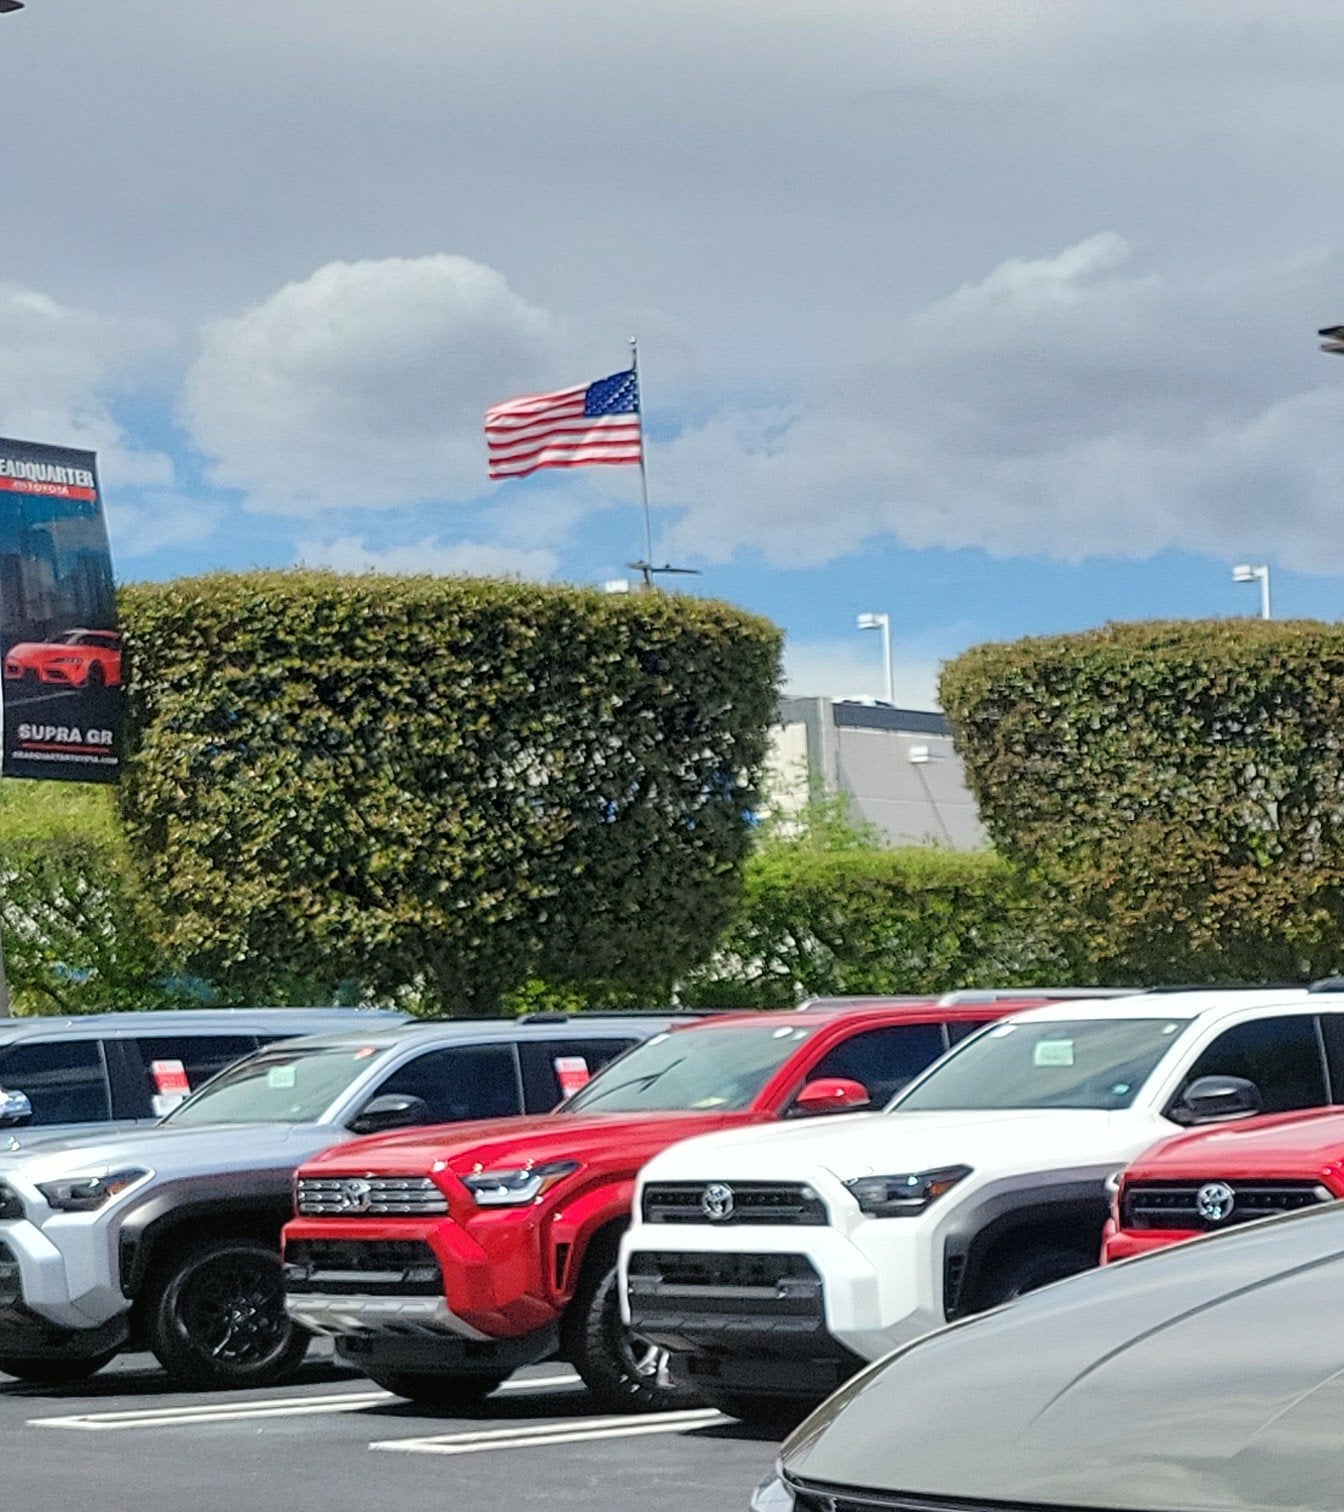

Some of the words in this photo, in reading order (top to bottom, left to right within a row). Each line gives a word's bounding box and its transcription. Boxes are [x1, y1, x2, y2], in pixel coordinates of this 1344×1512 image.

[26, 483, 70, 495] TOYOTA
[18, 723, 82, 742] SUPRA
[86, 728, 113, 745] GR
